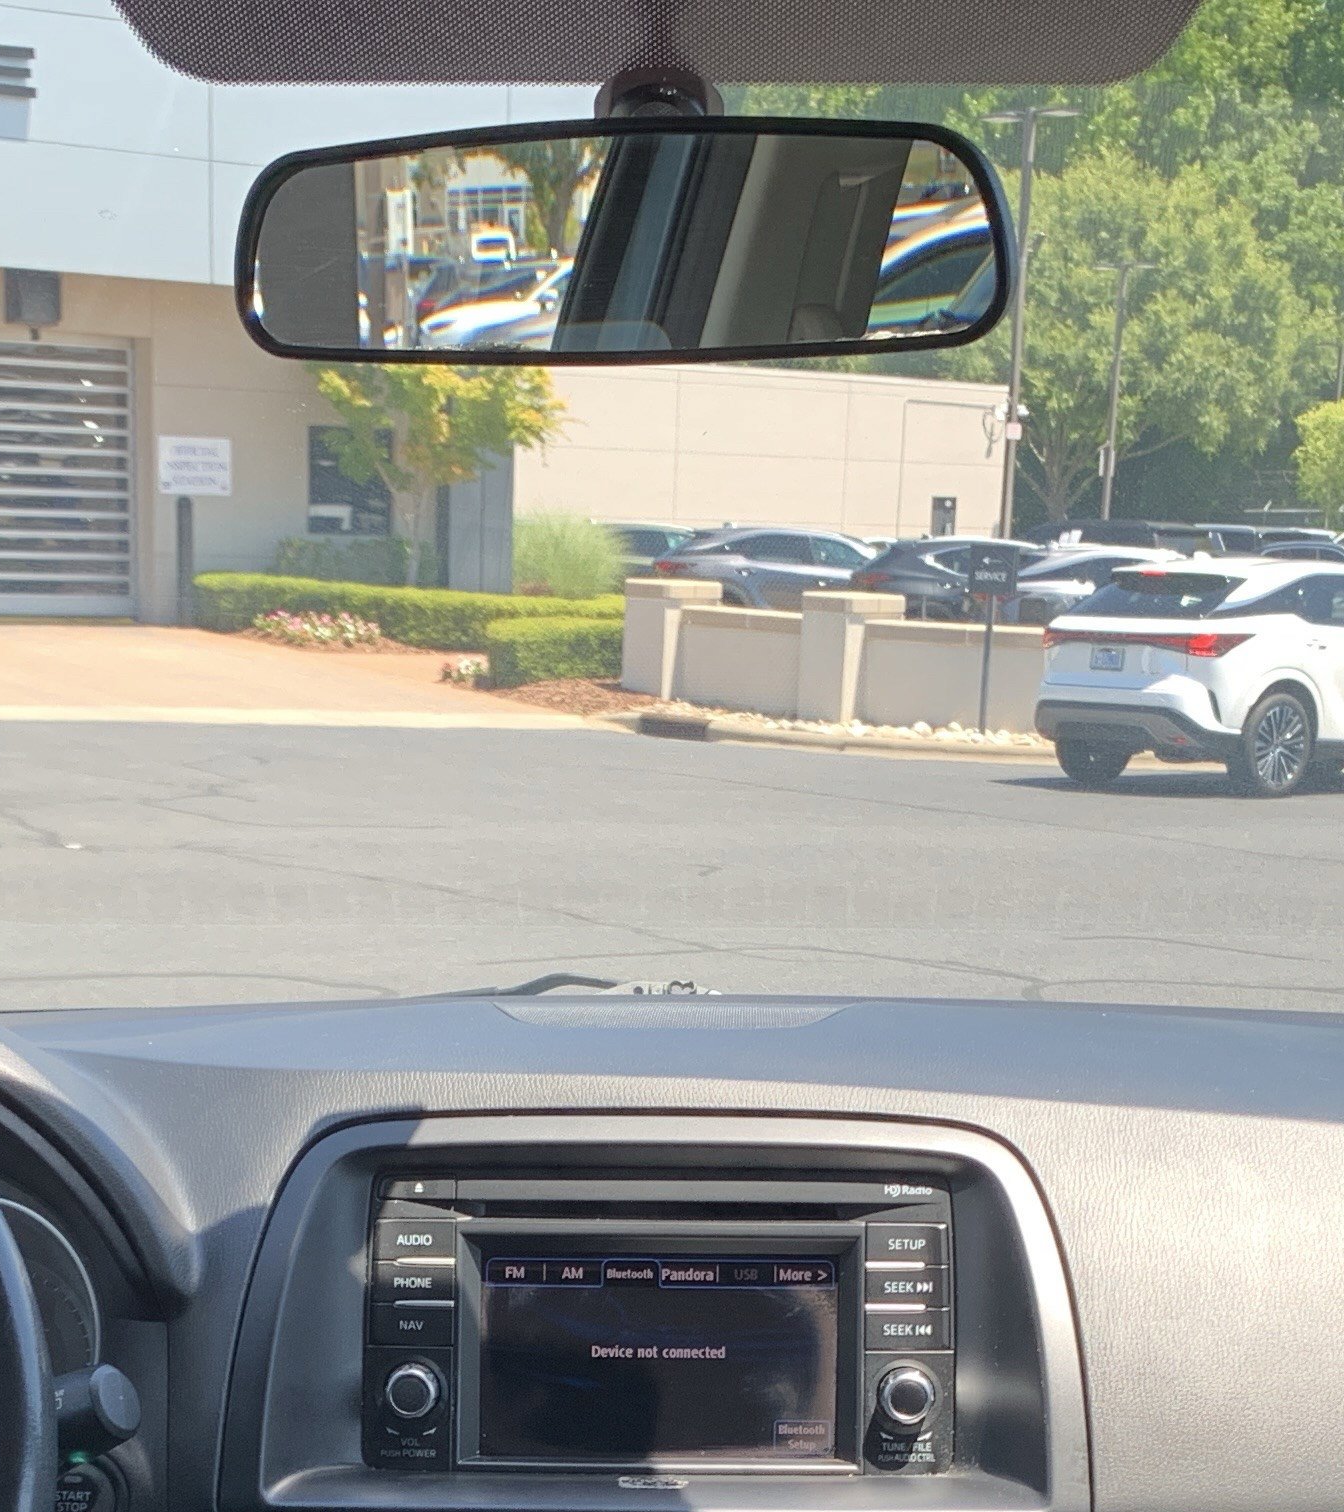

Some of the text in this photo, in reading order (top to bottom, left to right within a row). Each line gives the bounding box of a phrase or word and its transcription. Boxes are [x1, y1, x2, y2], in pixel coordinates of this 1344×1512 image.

[902, 1185, 933, 1196] Radio
[396, 1234, 432, 1246] AUDIO
[888, 1238, 926, 1250] SETUP
[505, 1266, 525, 1279] FM
[561, 1266, 584, 1279] AM
[606, 1268, 654, 1279] Bluetooth
[661, 1268, 714, 1281] Pandora
[734, 1268, 758, 1280] USB
[779, 1268, 812, 1281] More
[393, 1277, 432, 1289] PHONE
[884, 1281, 914, 1293] SEEK
[399, 1320, 424, 1331] NAV
[883, 1324, 913, 1336] SEEK
[591, 1344, 726, 1359] Device not connected
[778, 1424, 825, 1435] Bluetooth
[400, 1438, 420, 1447] VOL
[788, 1439, 816, 1452] Setup
[402, 1449, 436, 1458] POWER
[57, 1502, 88, 1512] STOP
